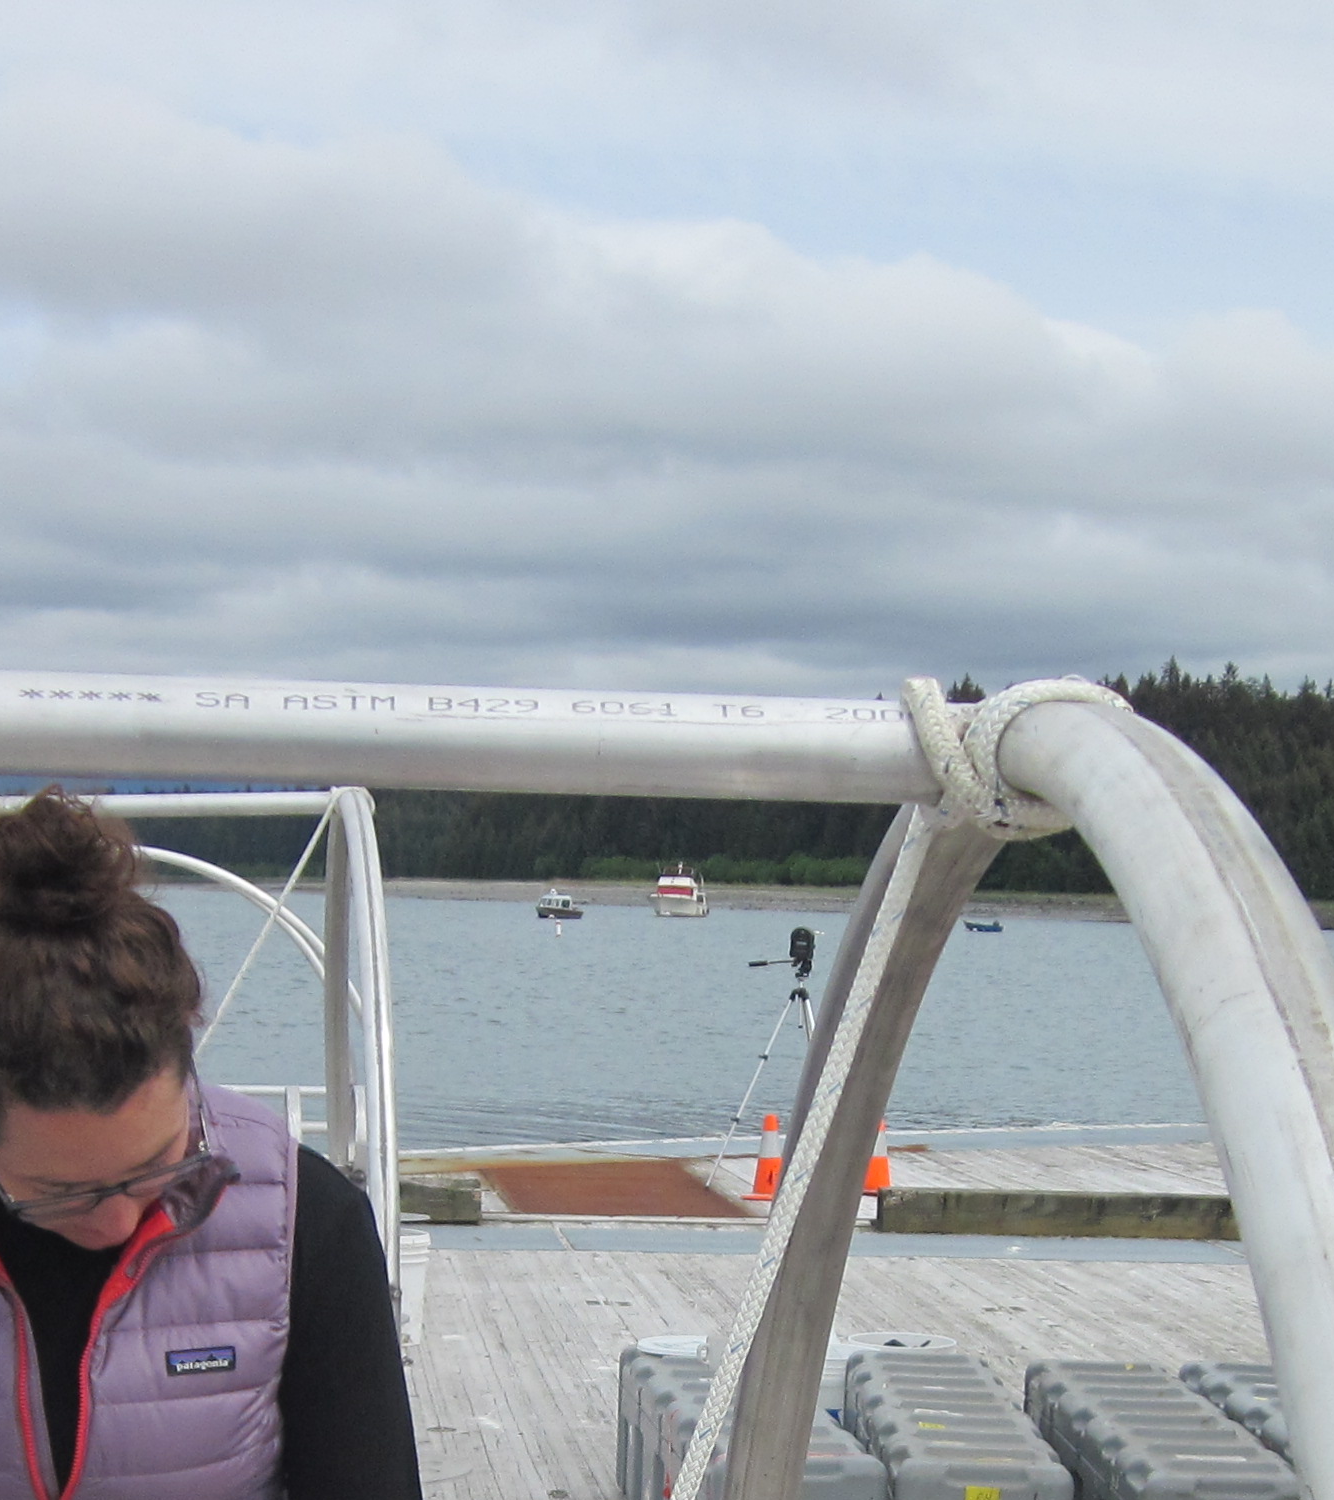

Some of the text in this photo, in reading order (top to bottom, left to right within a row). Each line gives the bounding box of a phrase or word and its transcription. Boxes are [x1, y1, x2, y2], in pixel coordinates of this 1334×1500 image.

[194, 691, 250, 709] SA
[283, 693, 396, 712] ASTM
[428, 696, 539, 714] B429
[571, 699, 677, 718] 6061
[714, 703, 765, 719] T6
[825, 706, 914, 721] 200
[176, 1359, 228, 1372] patagonia
